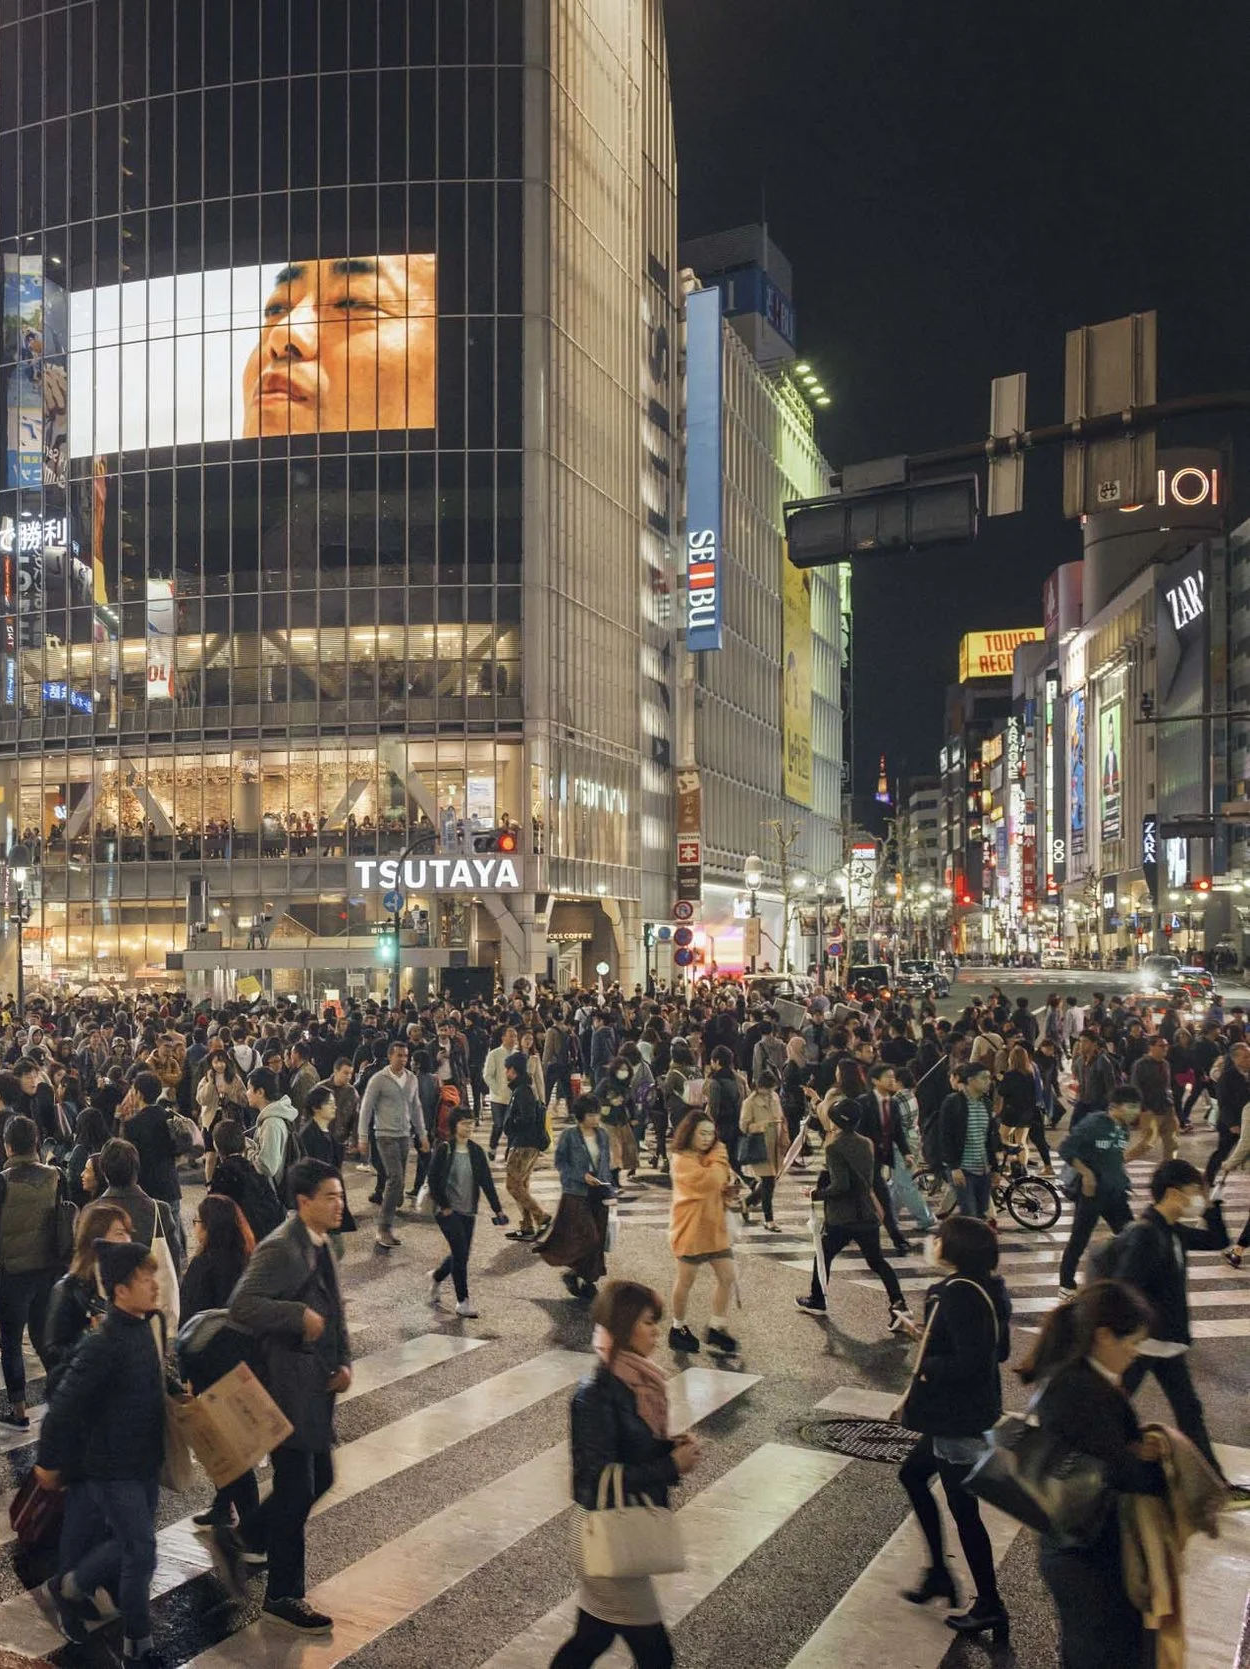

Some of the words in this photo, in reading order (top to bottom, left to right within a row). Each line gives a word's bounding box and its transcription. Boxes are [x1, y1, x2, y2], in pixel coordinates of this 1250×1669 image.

[688, 530, 715, 629] SEIBU
[681, 845, 697, 860] 本
[1144, 822, 1156, 863] ZARA
[355, 859, 519, 889] TSUTAYA
